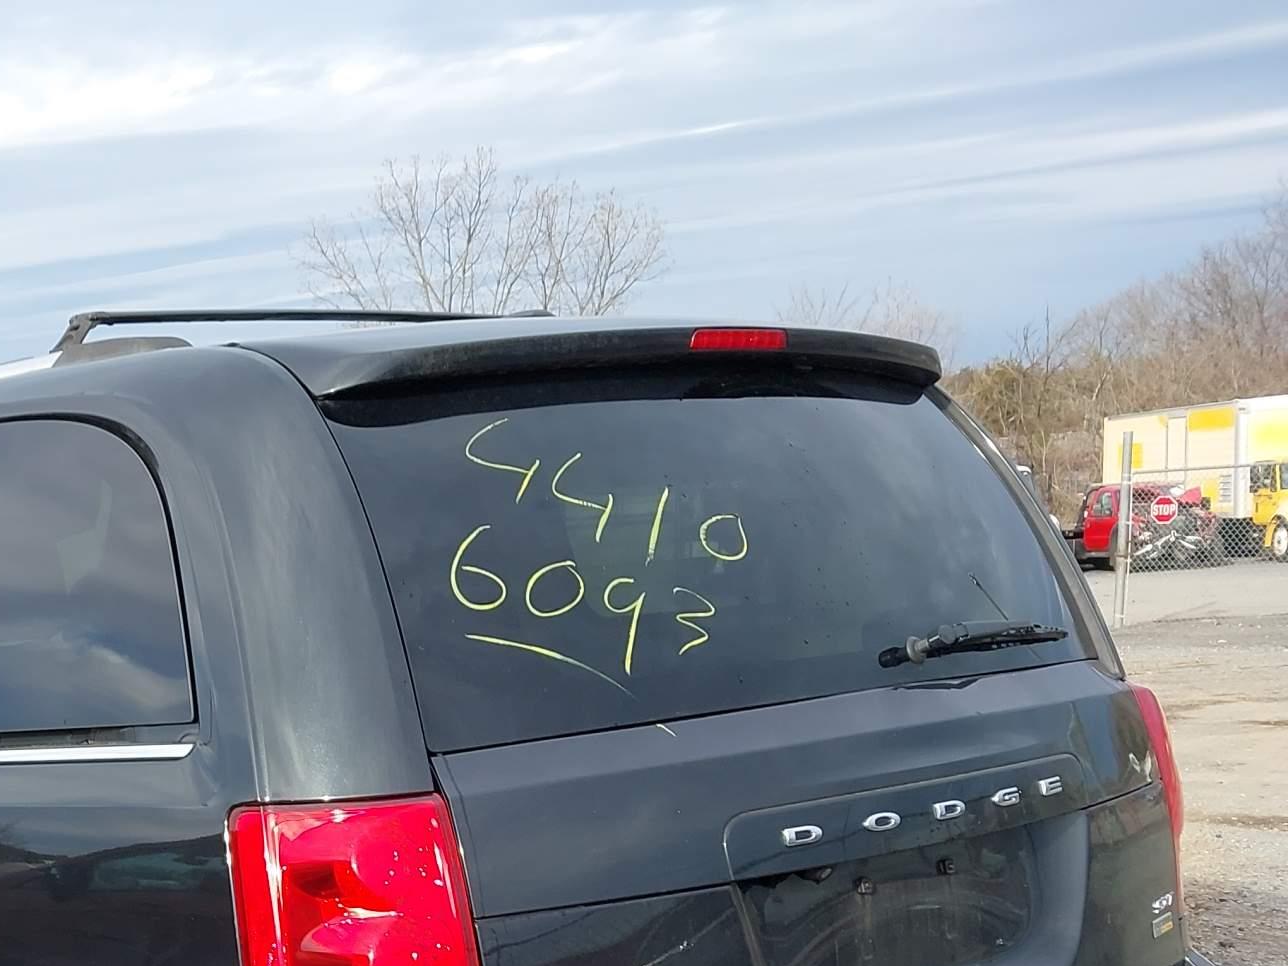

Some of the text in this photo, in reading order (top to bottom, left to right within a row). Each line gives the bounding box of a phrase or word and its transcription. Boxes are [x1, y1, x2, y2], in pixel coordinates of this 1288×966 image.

[464, 416, 749, 566] 4410
[1152, 503, 1177, 517] STOP
[449, 523, 717, 676] 6093
[780, 774, 1067, 848] DODGE
